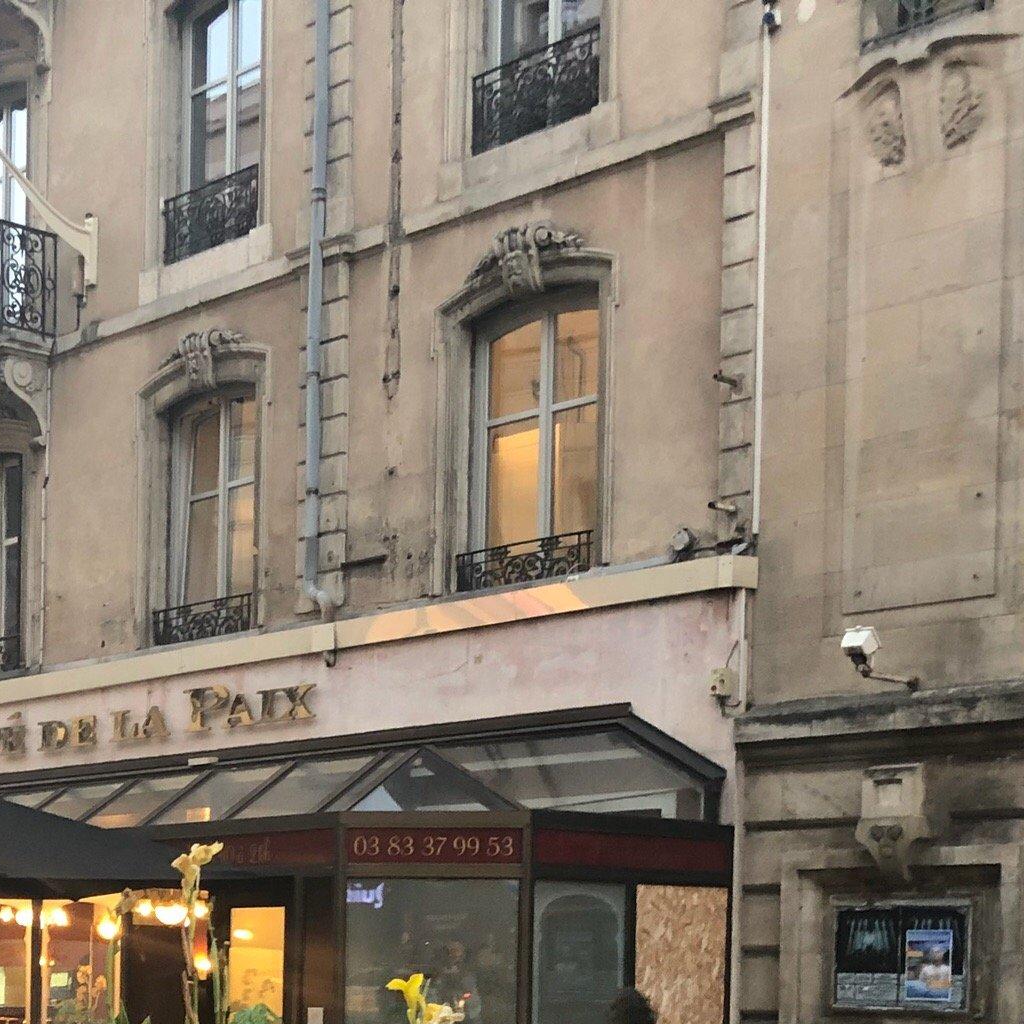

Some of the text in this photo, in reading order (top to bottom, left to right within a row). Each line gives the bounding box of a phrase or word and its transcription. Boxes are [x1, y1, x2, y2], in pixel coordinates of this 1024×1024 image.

[37, 715, 98, 753] DE
[109, 705, 172, 743] LA
[182, 682, 318, 734] PAIX
[352, 835, 514, 857] 03 83 37 99 53
